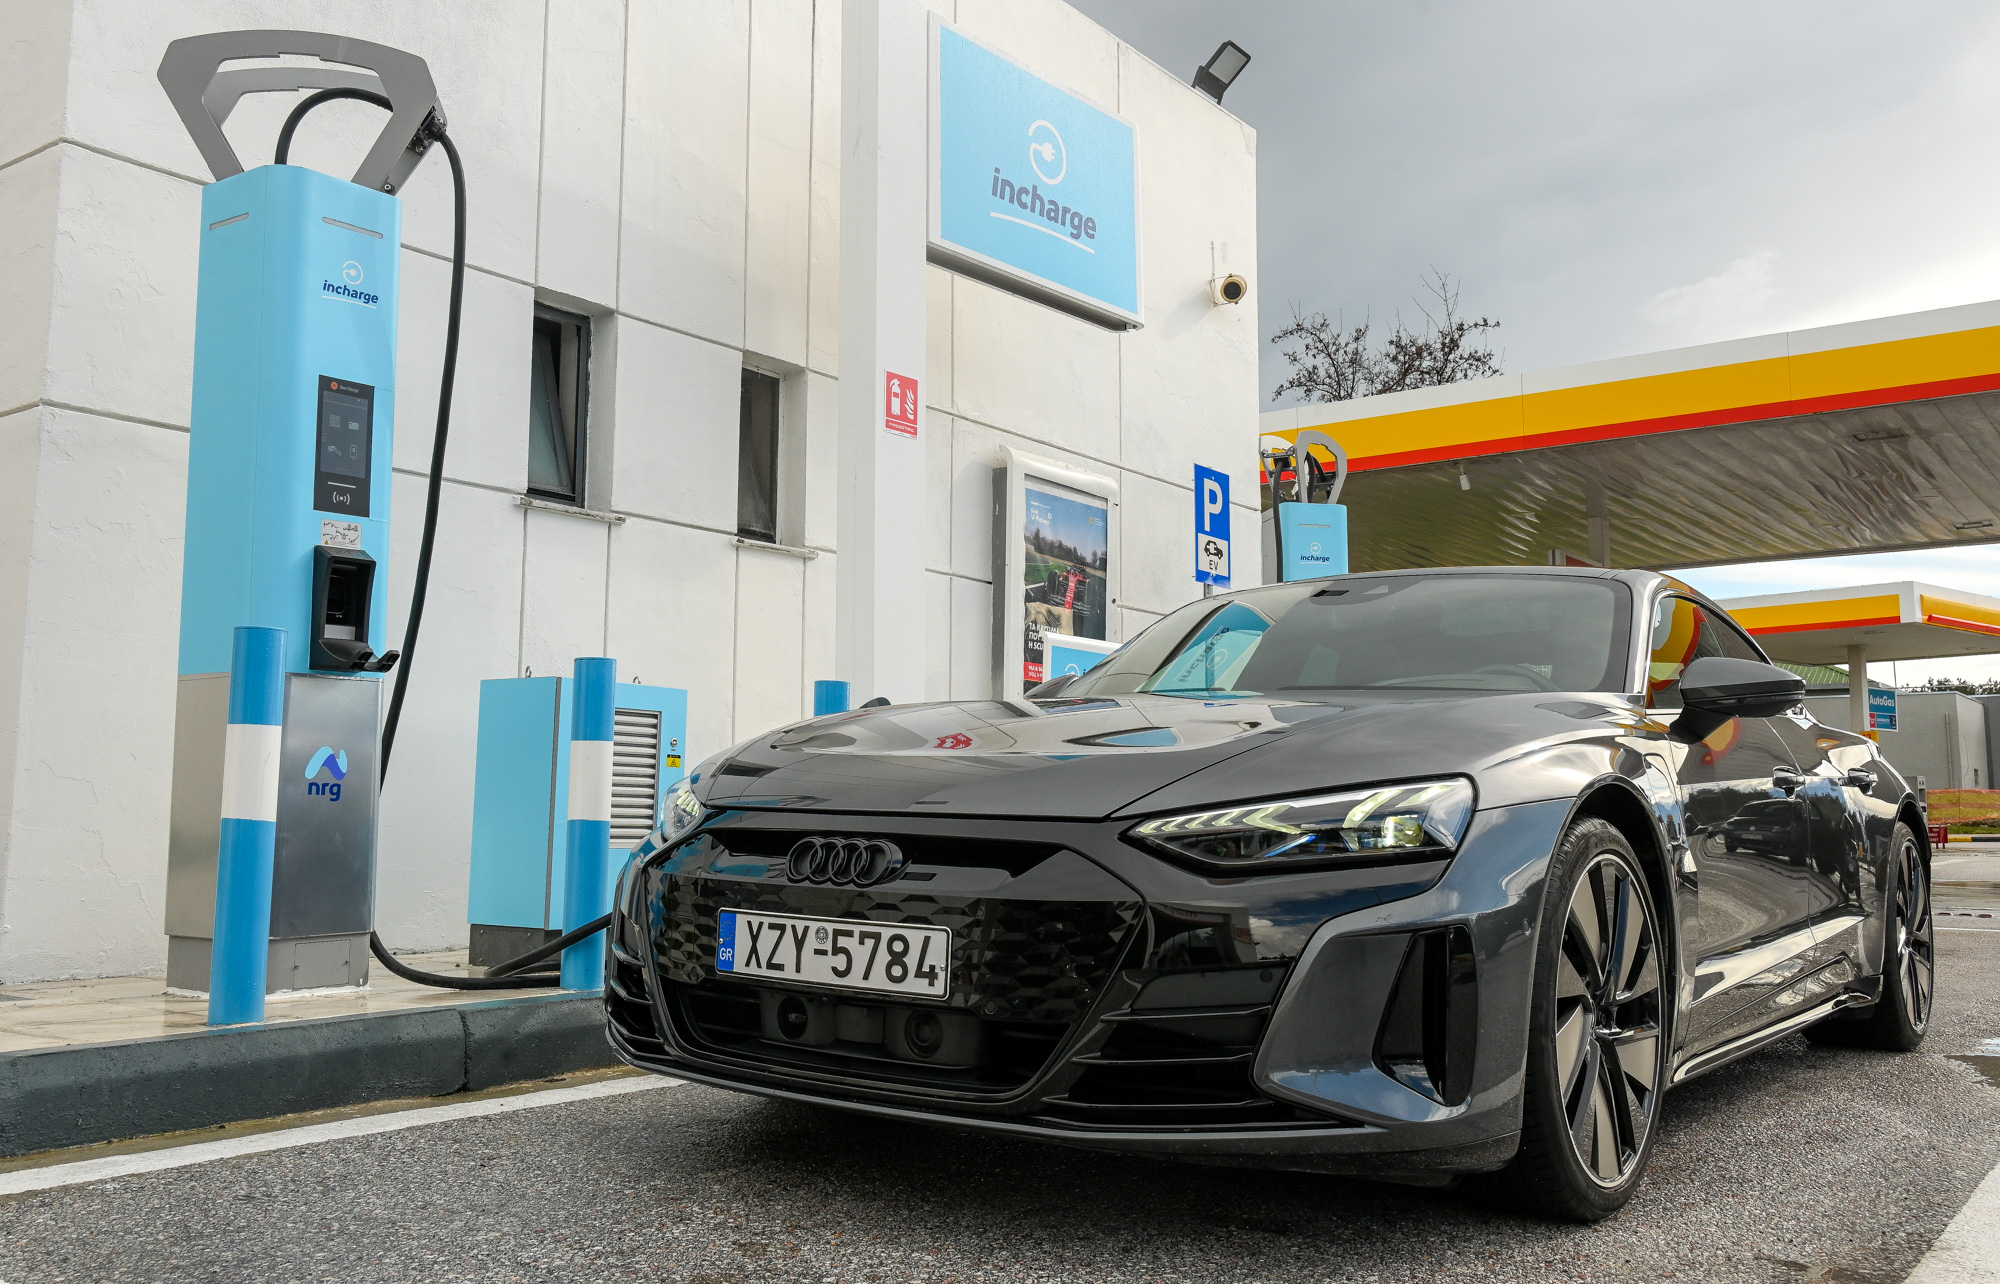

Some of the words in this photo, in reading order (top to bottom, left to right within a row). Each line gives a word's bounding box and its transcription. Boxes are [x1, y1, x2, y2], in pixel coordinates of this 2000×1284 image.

[991, 166, 1096, 240] incharge
[322, 279, 379, 304] incharge
[1203, 477, 1223, 532] P
[1208, 560, 1219, 571] EV
[1300, 554, 1330, 562] incharge
[1869, 694, 1895, 707] AutoGas
[307, 781, 342, 802] nrg
[719, 947, 733, 962] GR
[743, 920, 939, 987] XZY-5784
